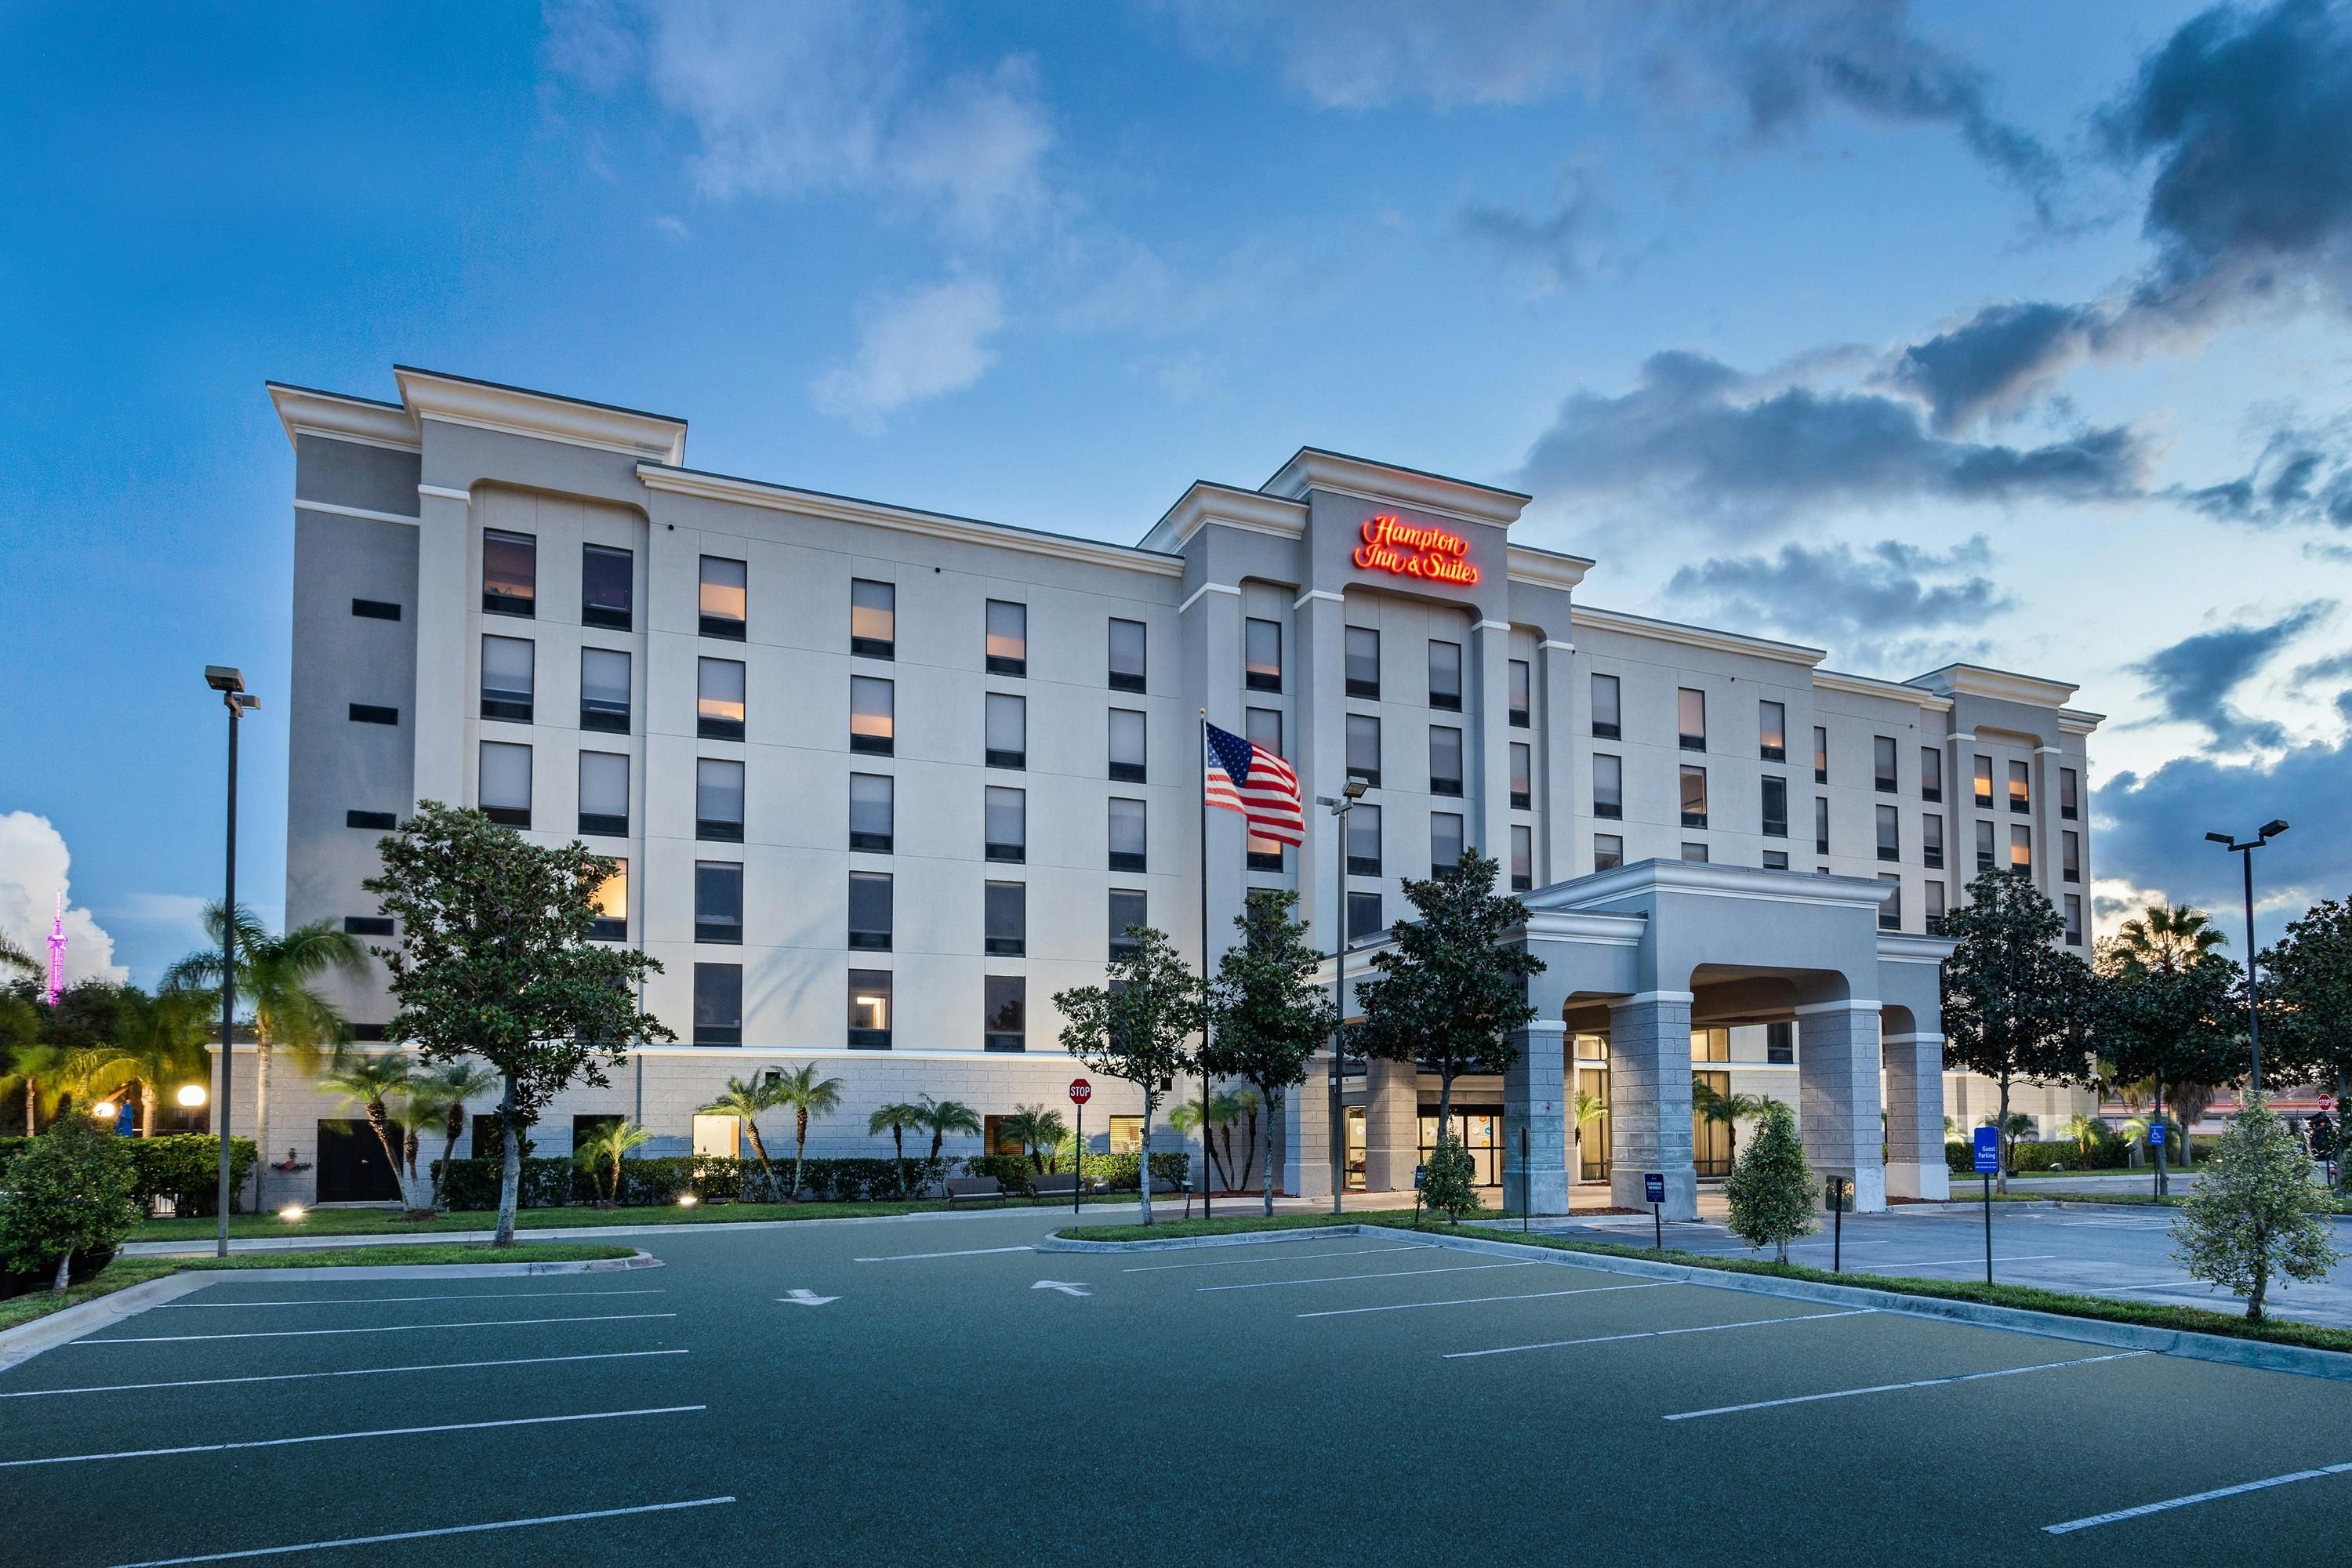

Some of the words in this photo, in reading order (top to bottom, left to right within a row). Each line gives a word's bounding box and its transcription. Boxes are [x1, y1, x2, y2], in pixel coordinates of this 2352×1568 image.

[1361, 514, 1468, 557] Hampton
[1353, 543, 1406, 573] Inn
[1408, 555, 1423, 576] &
[1423, 554, 1480, 584] Suites
[1070, 1086, 1091, 1097] STOP
